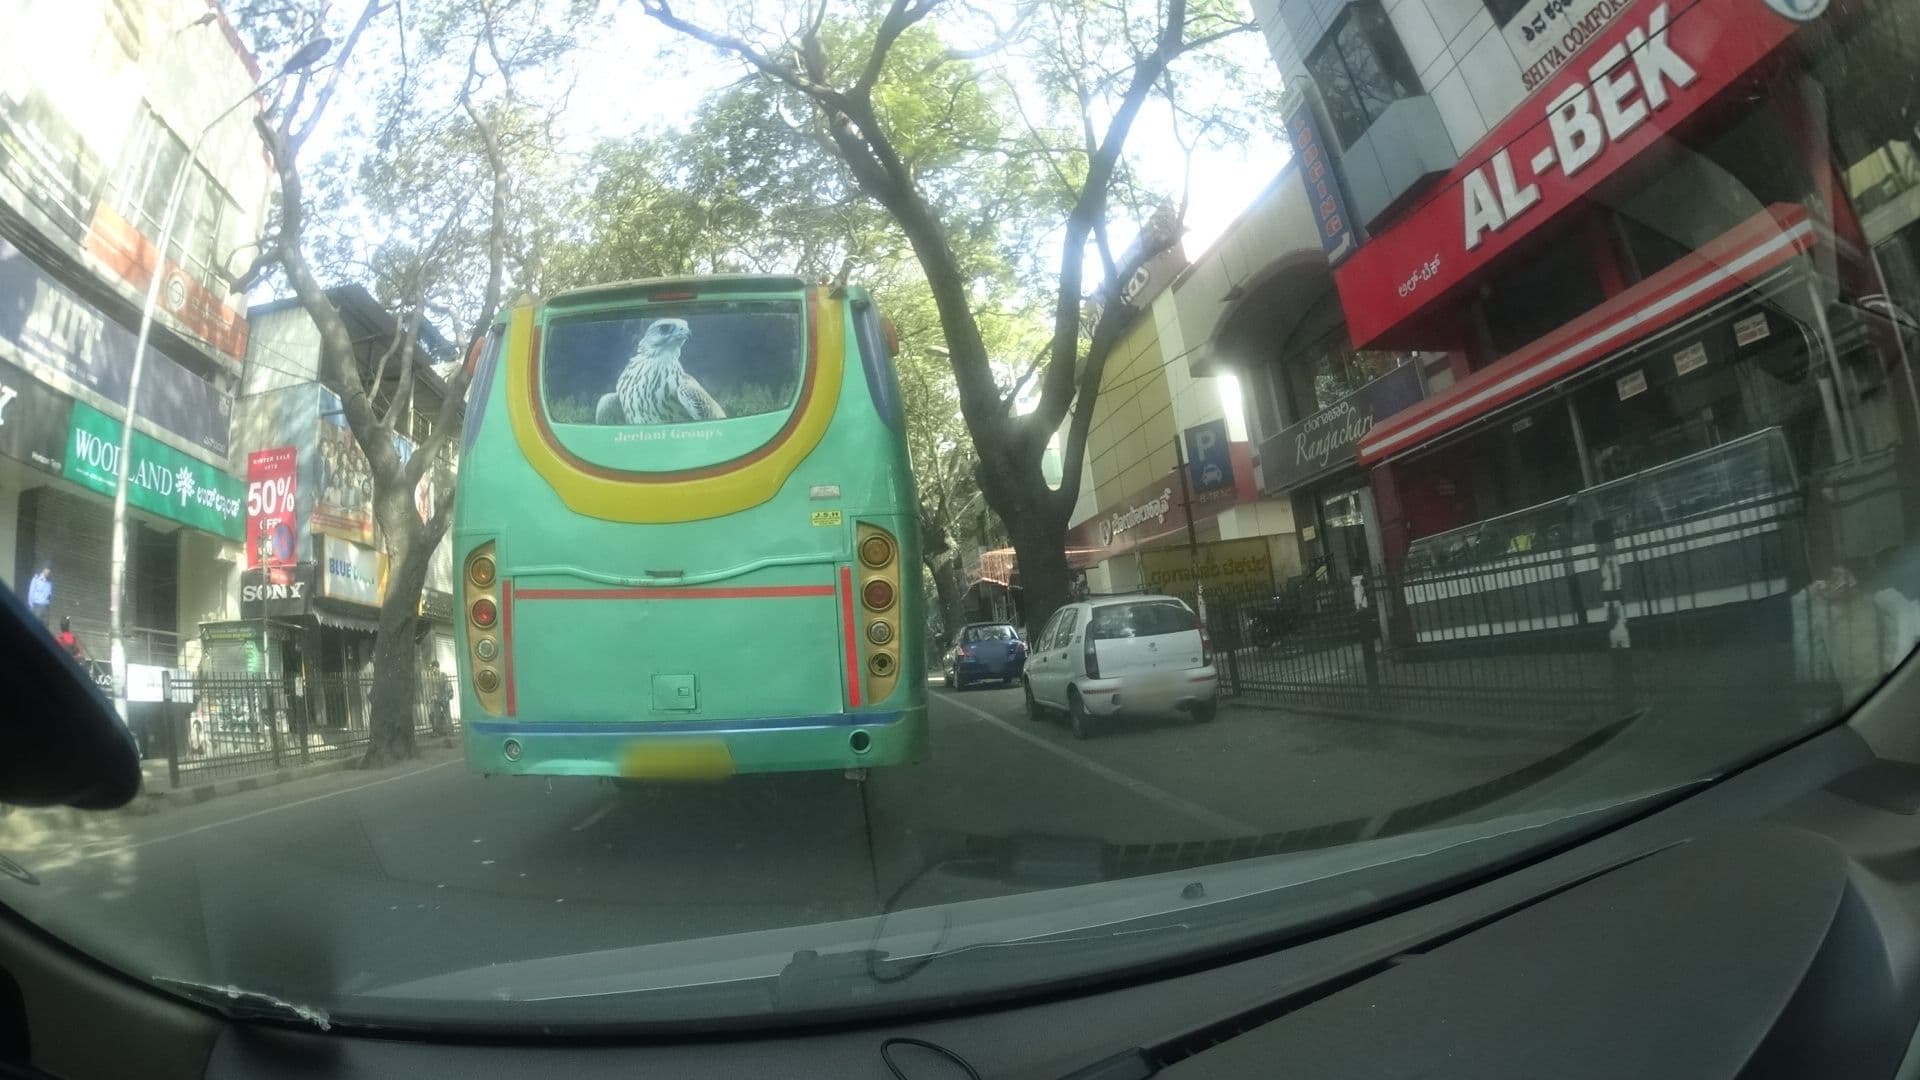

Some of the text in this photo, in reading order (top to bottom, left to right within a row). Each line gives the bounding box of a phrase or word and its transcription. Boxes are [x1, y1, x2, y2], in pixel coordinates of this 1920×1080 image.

[1521, 0, 1632, 91] SHIVA COMFOR
[1463, 2, 1697, 251] AL-BEK
[75, 427, 173, 496] WOOAND
[1295, 406, 1375, 467] Rangachari
[248, 475, 295, 517] 50%
[242, 582, 304, 602] SONY
[329, 558, 352, 578] BLUE
